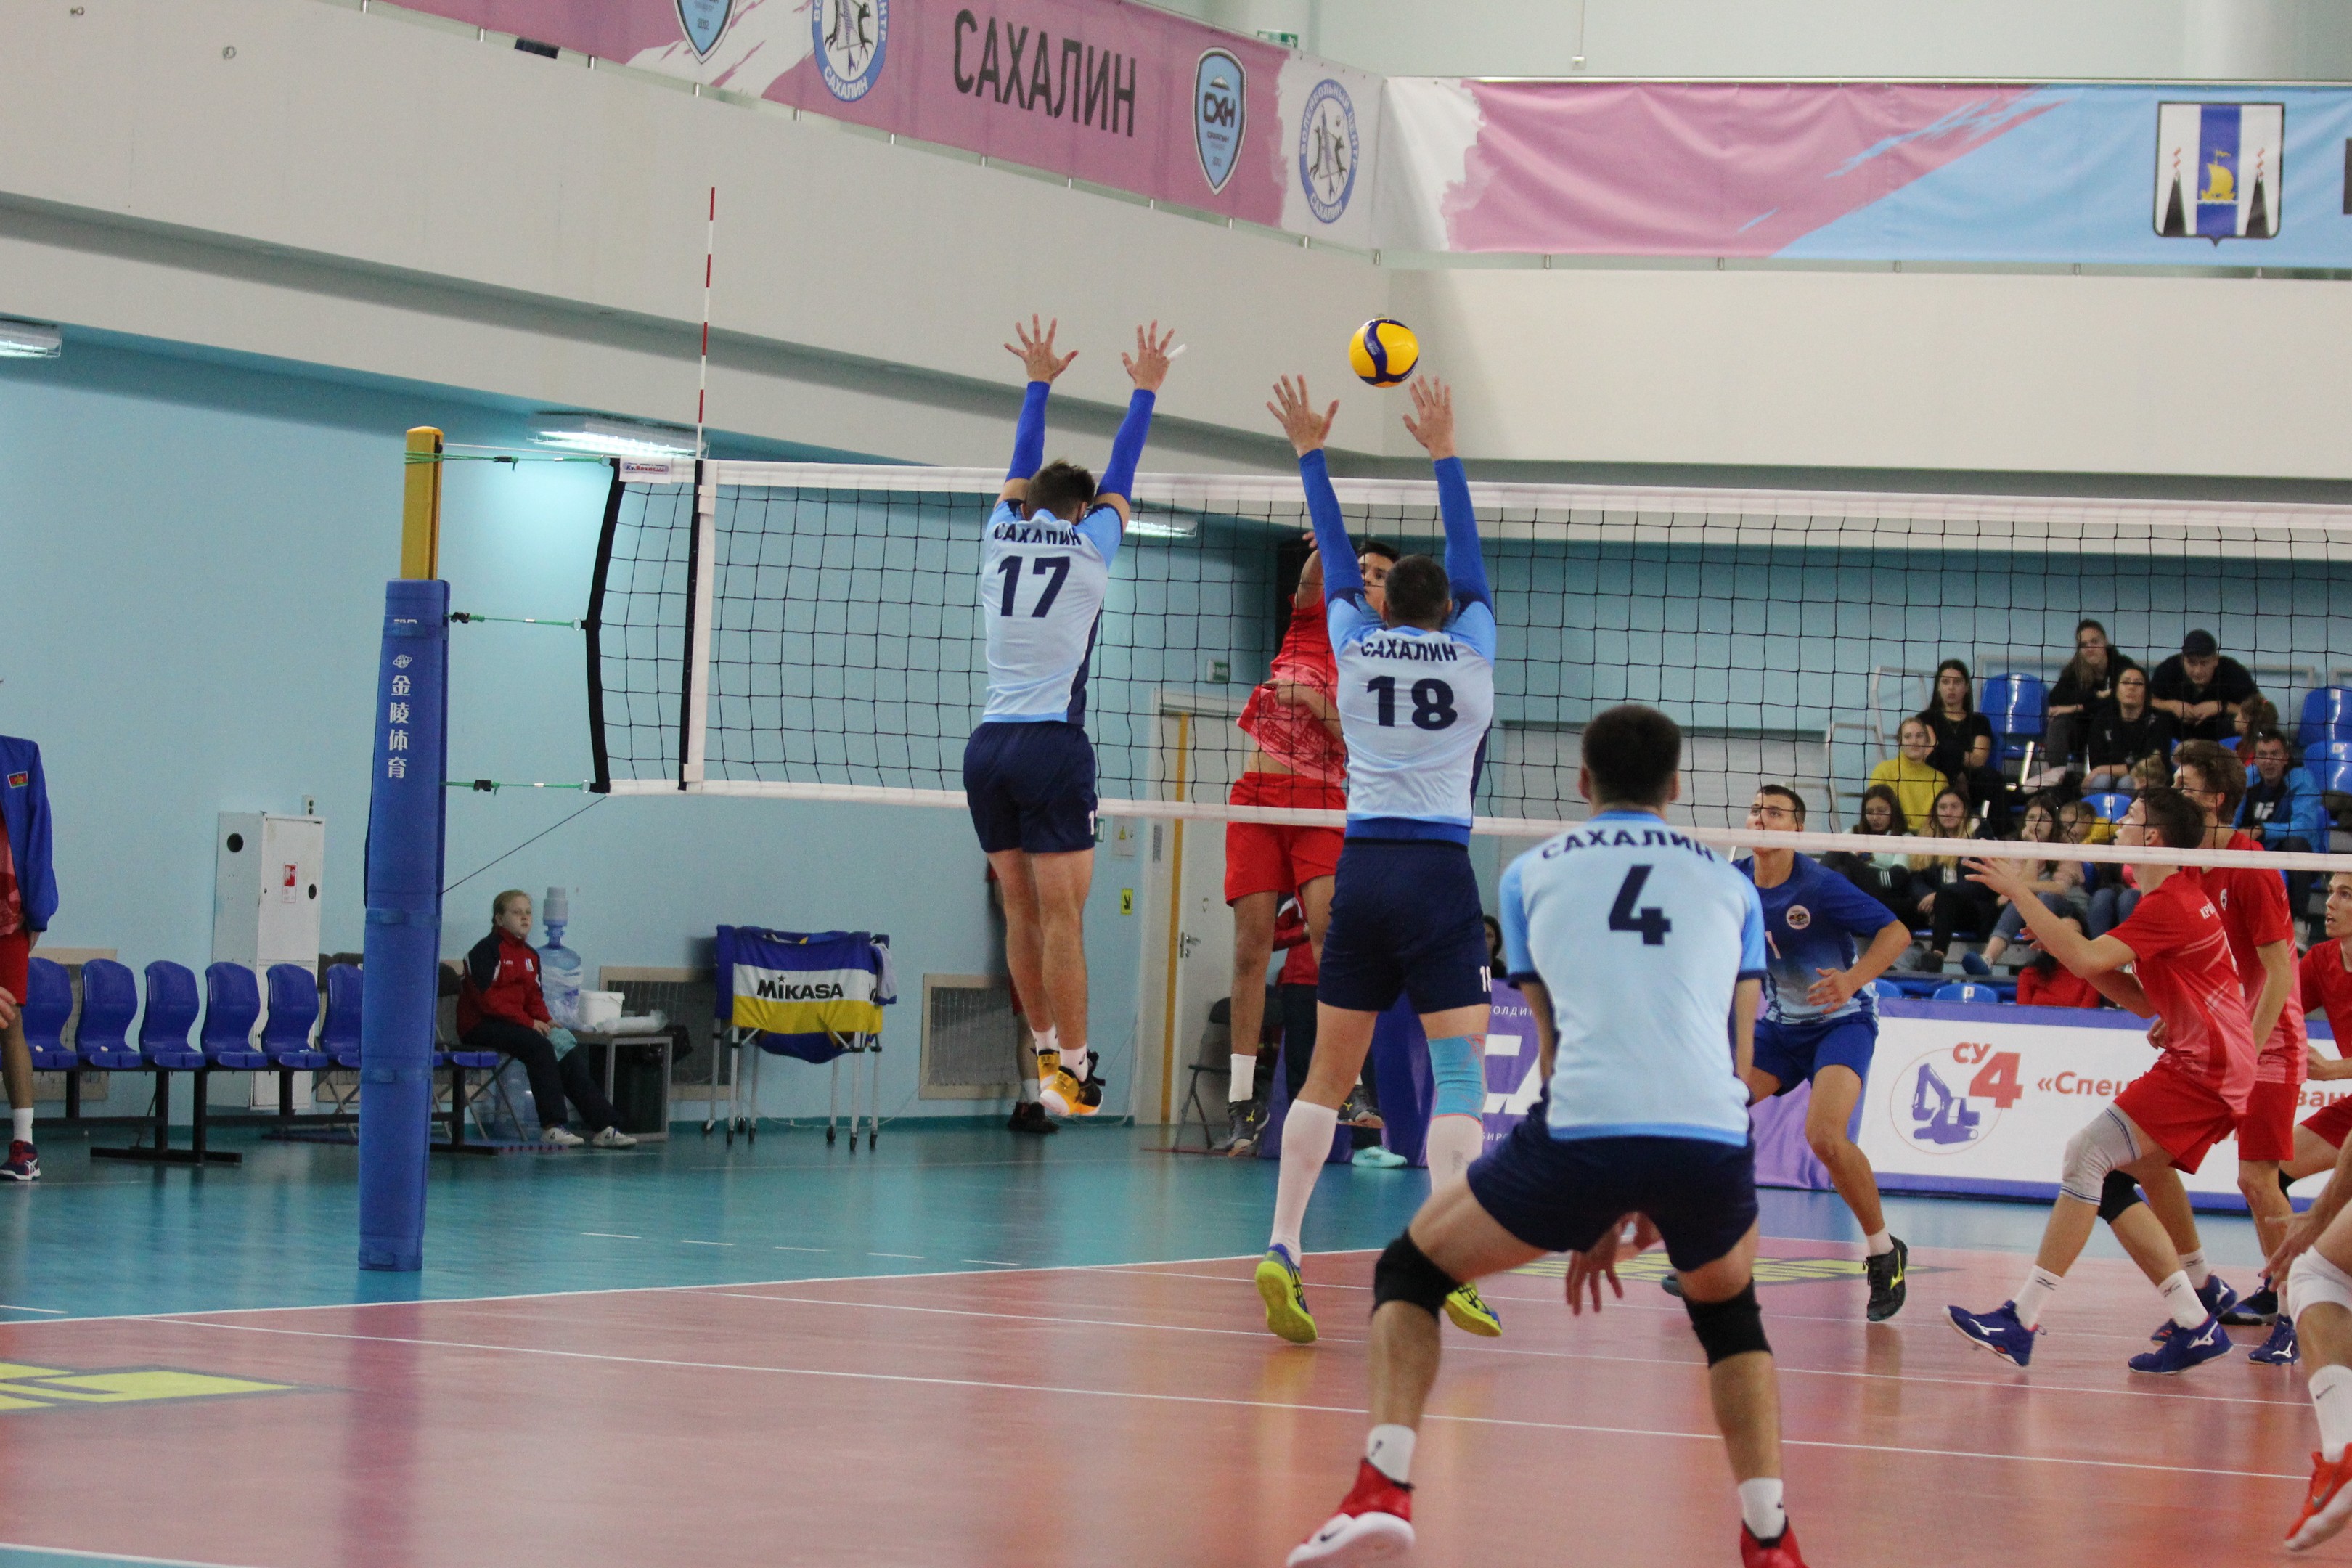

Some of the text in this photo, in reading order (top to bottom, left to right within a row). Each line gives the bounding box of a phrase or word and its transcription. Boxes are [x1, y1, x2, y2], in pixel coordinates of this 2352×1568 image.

[824, 65, 869, 99] САХАЛИН
[952, 9, 1136, 137] САХАЛИН
[994, 523, 1082, 546] САХАЛИН
[997, 555, 1071, 618] 17
[1360, 639, 1458, 661] САХАЛИН
[387, 674, 412, 780] 金陵体育
[1367, 675, 1458, 730] 18
[1541, 828, 1715, 862] САХАЛИН
[1608, 864, 1673, 946] 4
[756, 975, 844, 1000] MIKASA
[1953, 1042, 2024, 1108] СУ 4
